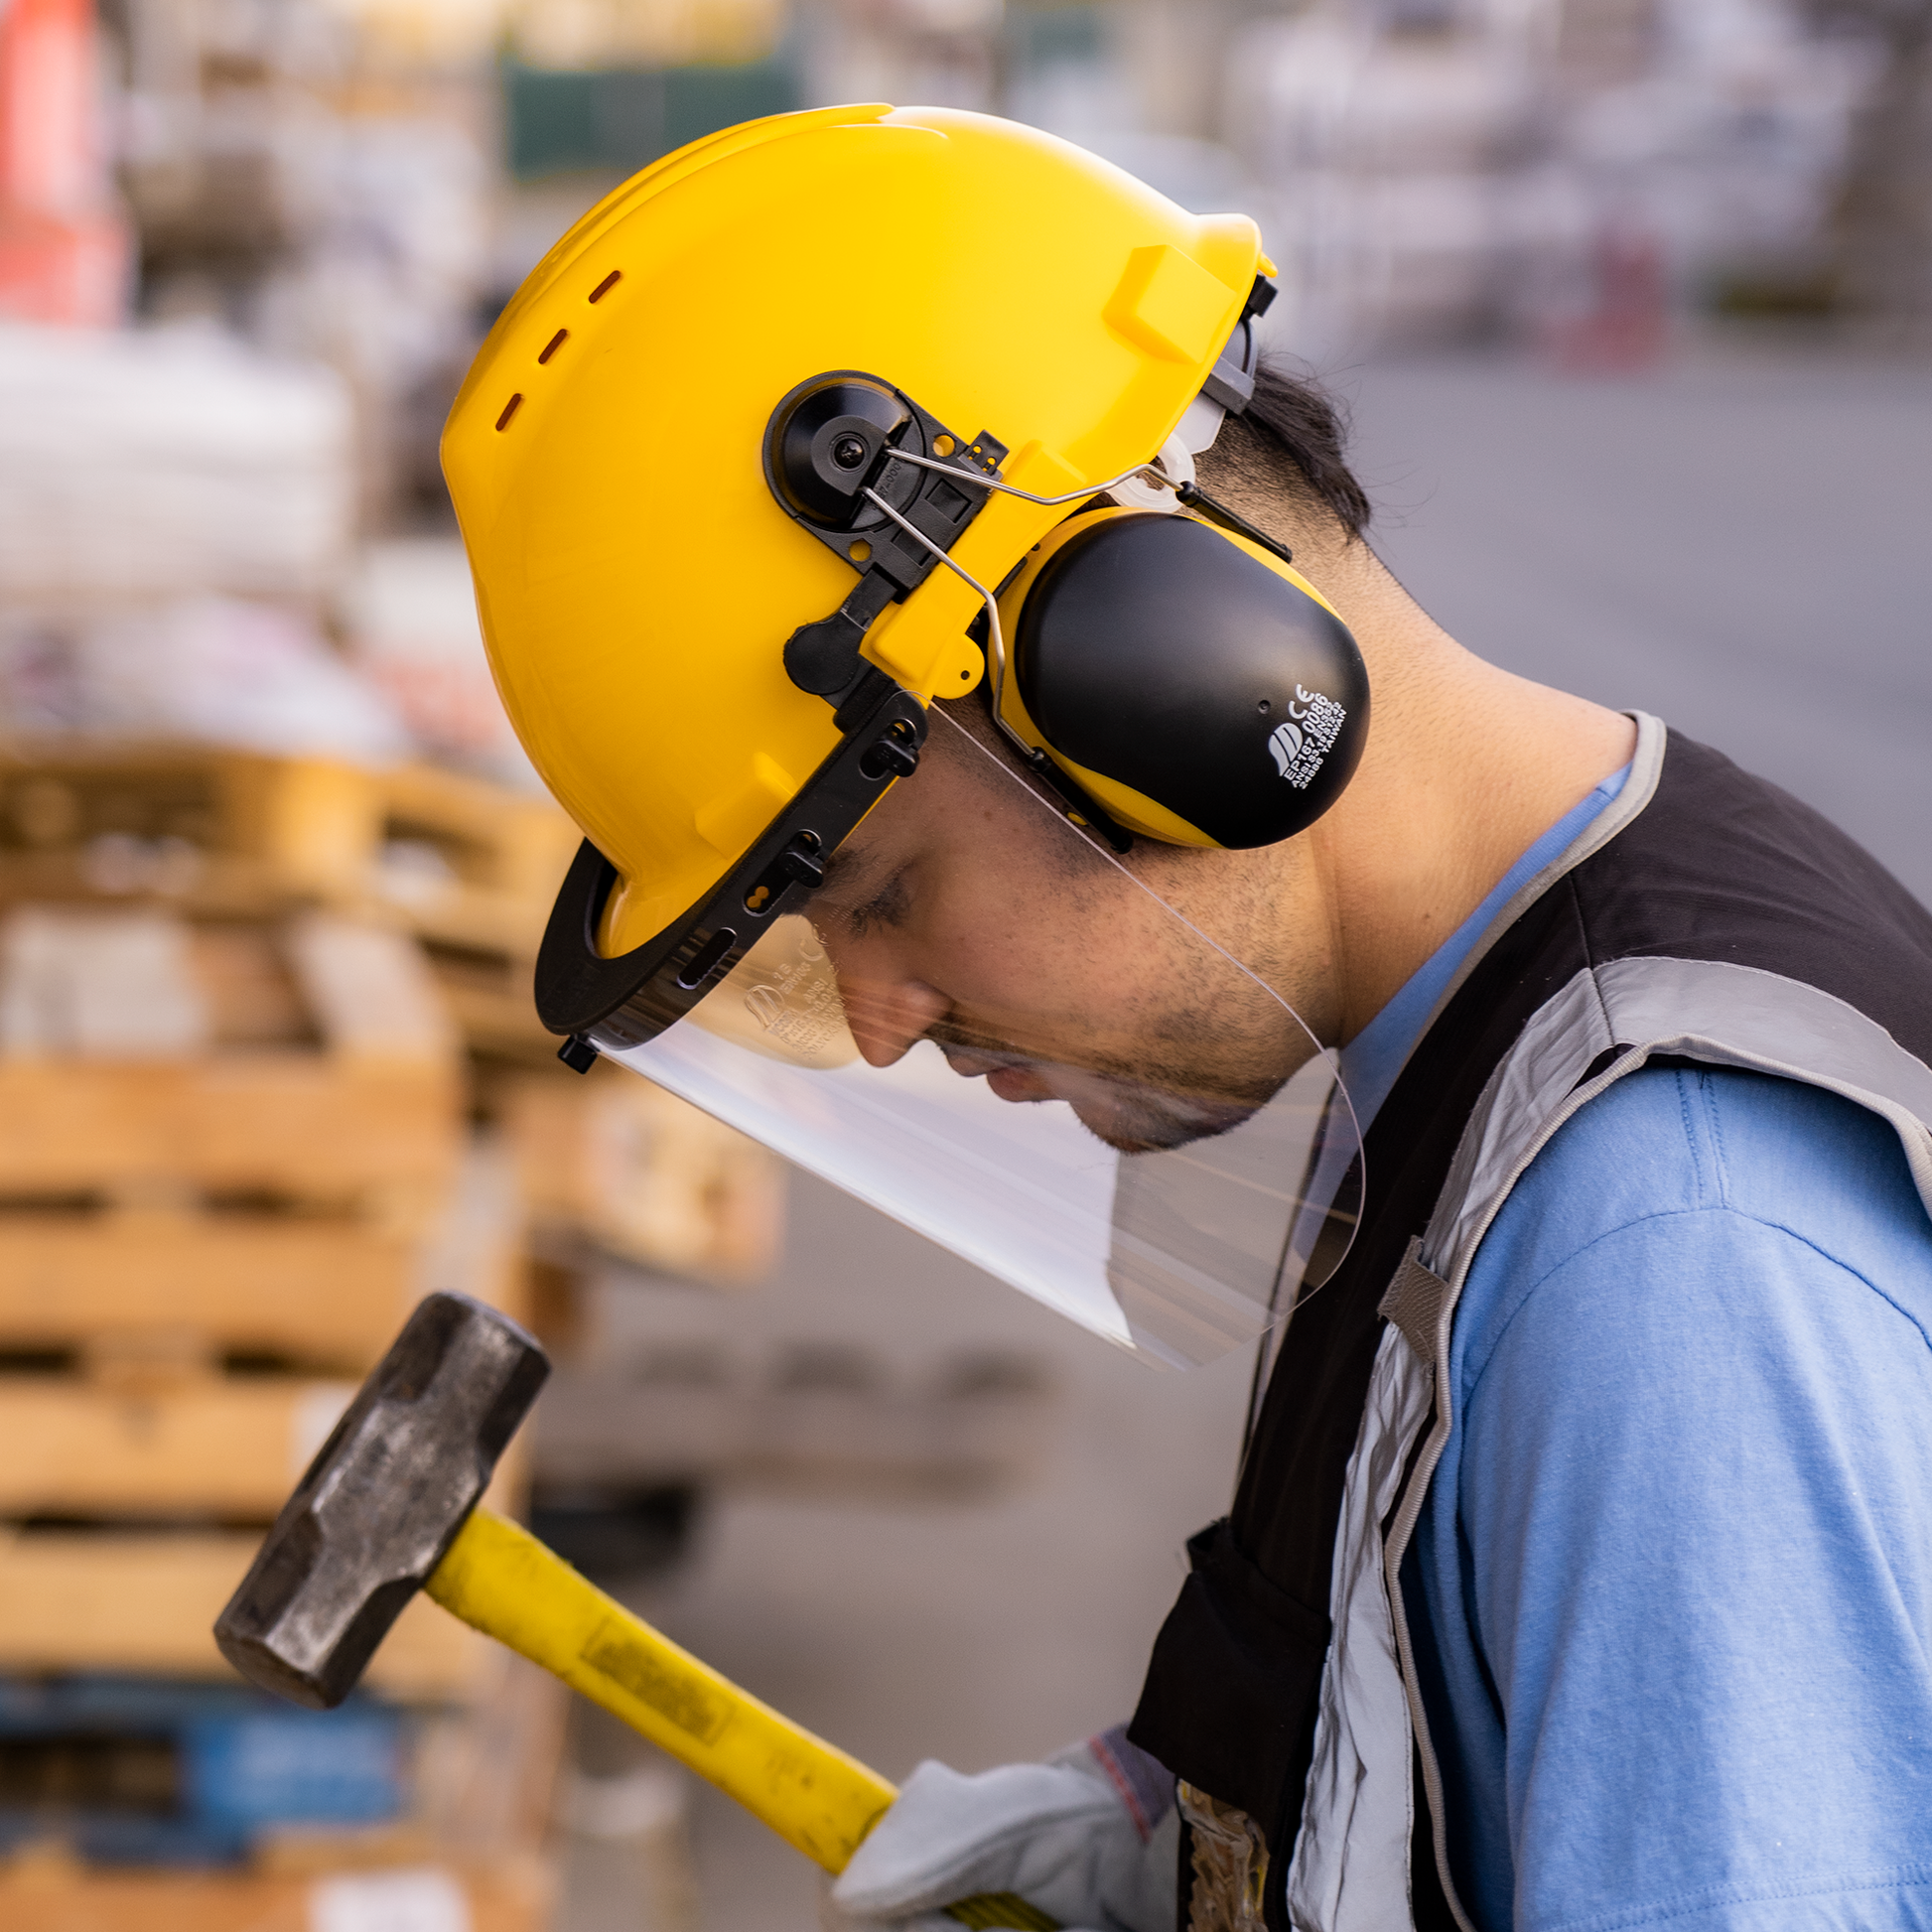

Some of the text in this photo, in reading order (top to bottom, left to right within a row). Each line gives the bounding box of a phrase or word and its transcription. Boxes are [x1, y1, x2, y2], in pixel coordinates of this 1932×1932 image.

[1289, 683, 1314, 719] CE
[1302, 693, 1328, 733] 0086
[1319, 708, 1347, 753] TAIWAN
[1283, 737, 1315, 781] EP167
[1291, 762, 1311, 788] ANSI
